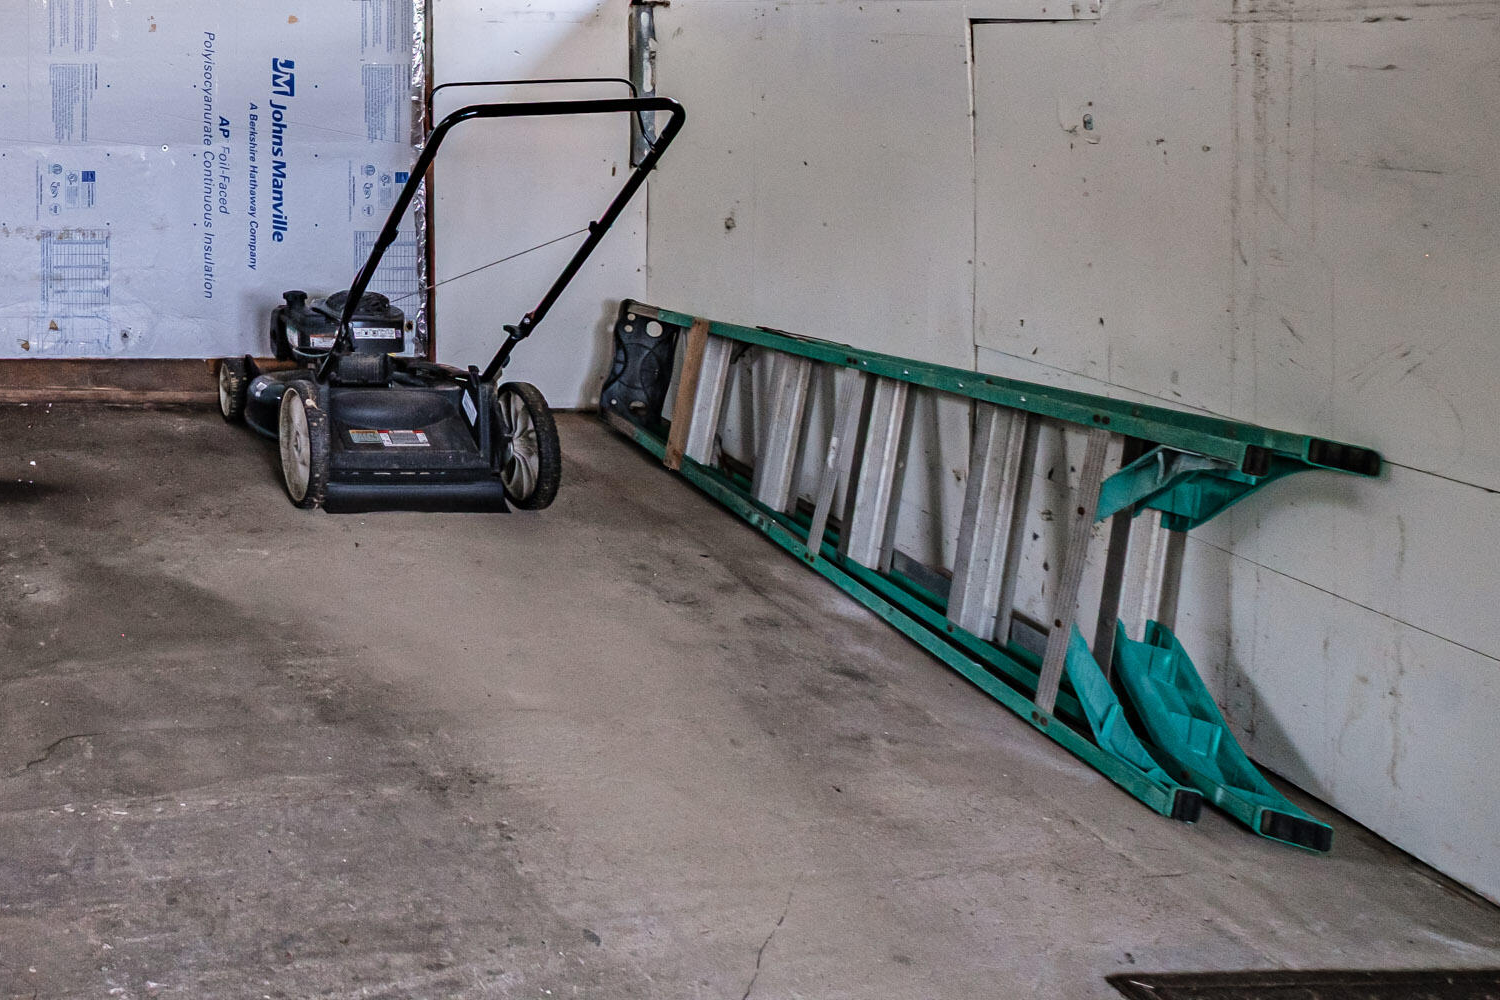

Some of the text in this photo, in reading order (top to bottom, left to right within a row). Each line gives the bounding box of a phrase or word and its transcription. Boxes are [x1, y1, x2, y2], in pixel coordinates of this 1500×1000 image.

[202, 32, 216, 299] Polyisocyanurate Continuous Insulation
[218, 116, 231, 215] AP Foil-Faced
[248, 103, 259, 270] A Berkshire Hathaway Company
[269, 99, 288, 243] Johns Manville
